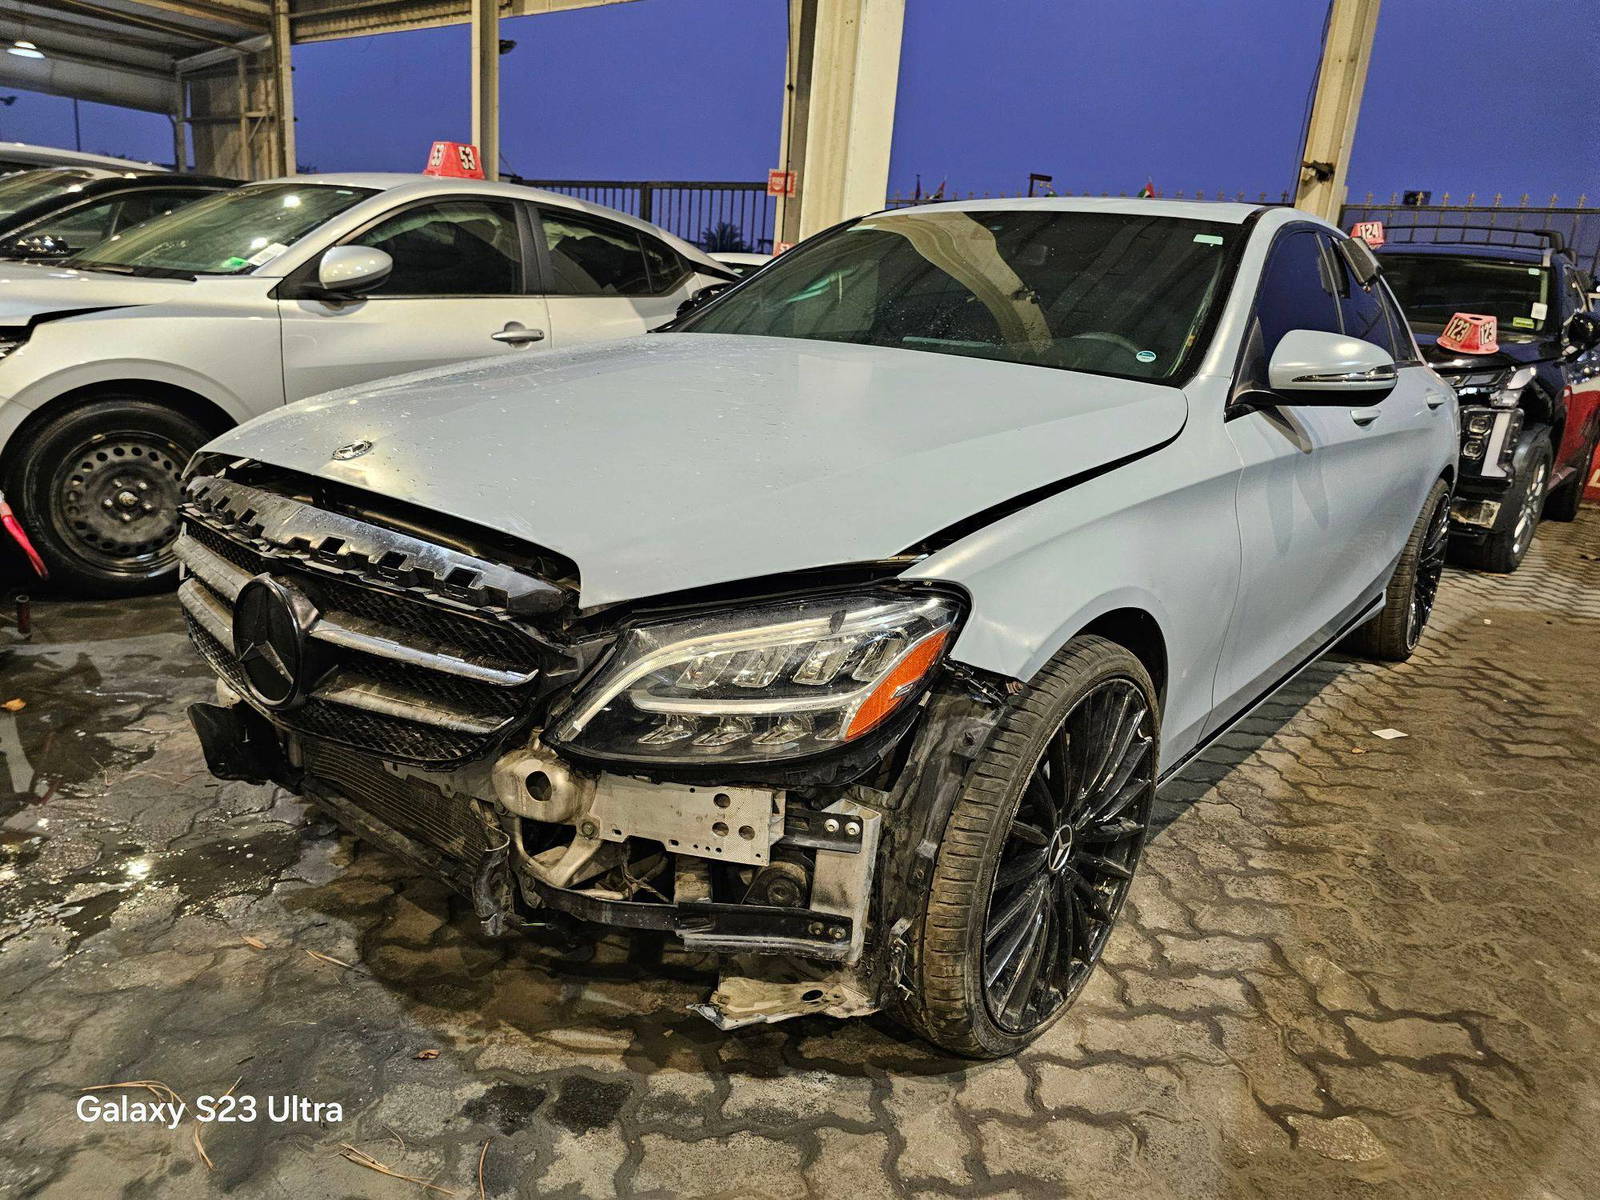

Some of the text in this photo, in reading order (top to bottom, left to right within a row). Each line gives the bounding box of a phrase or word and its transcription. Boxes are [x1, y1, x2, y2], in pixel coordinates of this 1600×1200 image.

[458, 145, 476, 170] 53
[1360, 223, 1380, 240] 124
[1446, 317, 1470, 342] 123
[1481, 321, 1496, 345] 123
